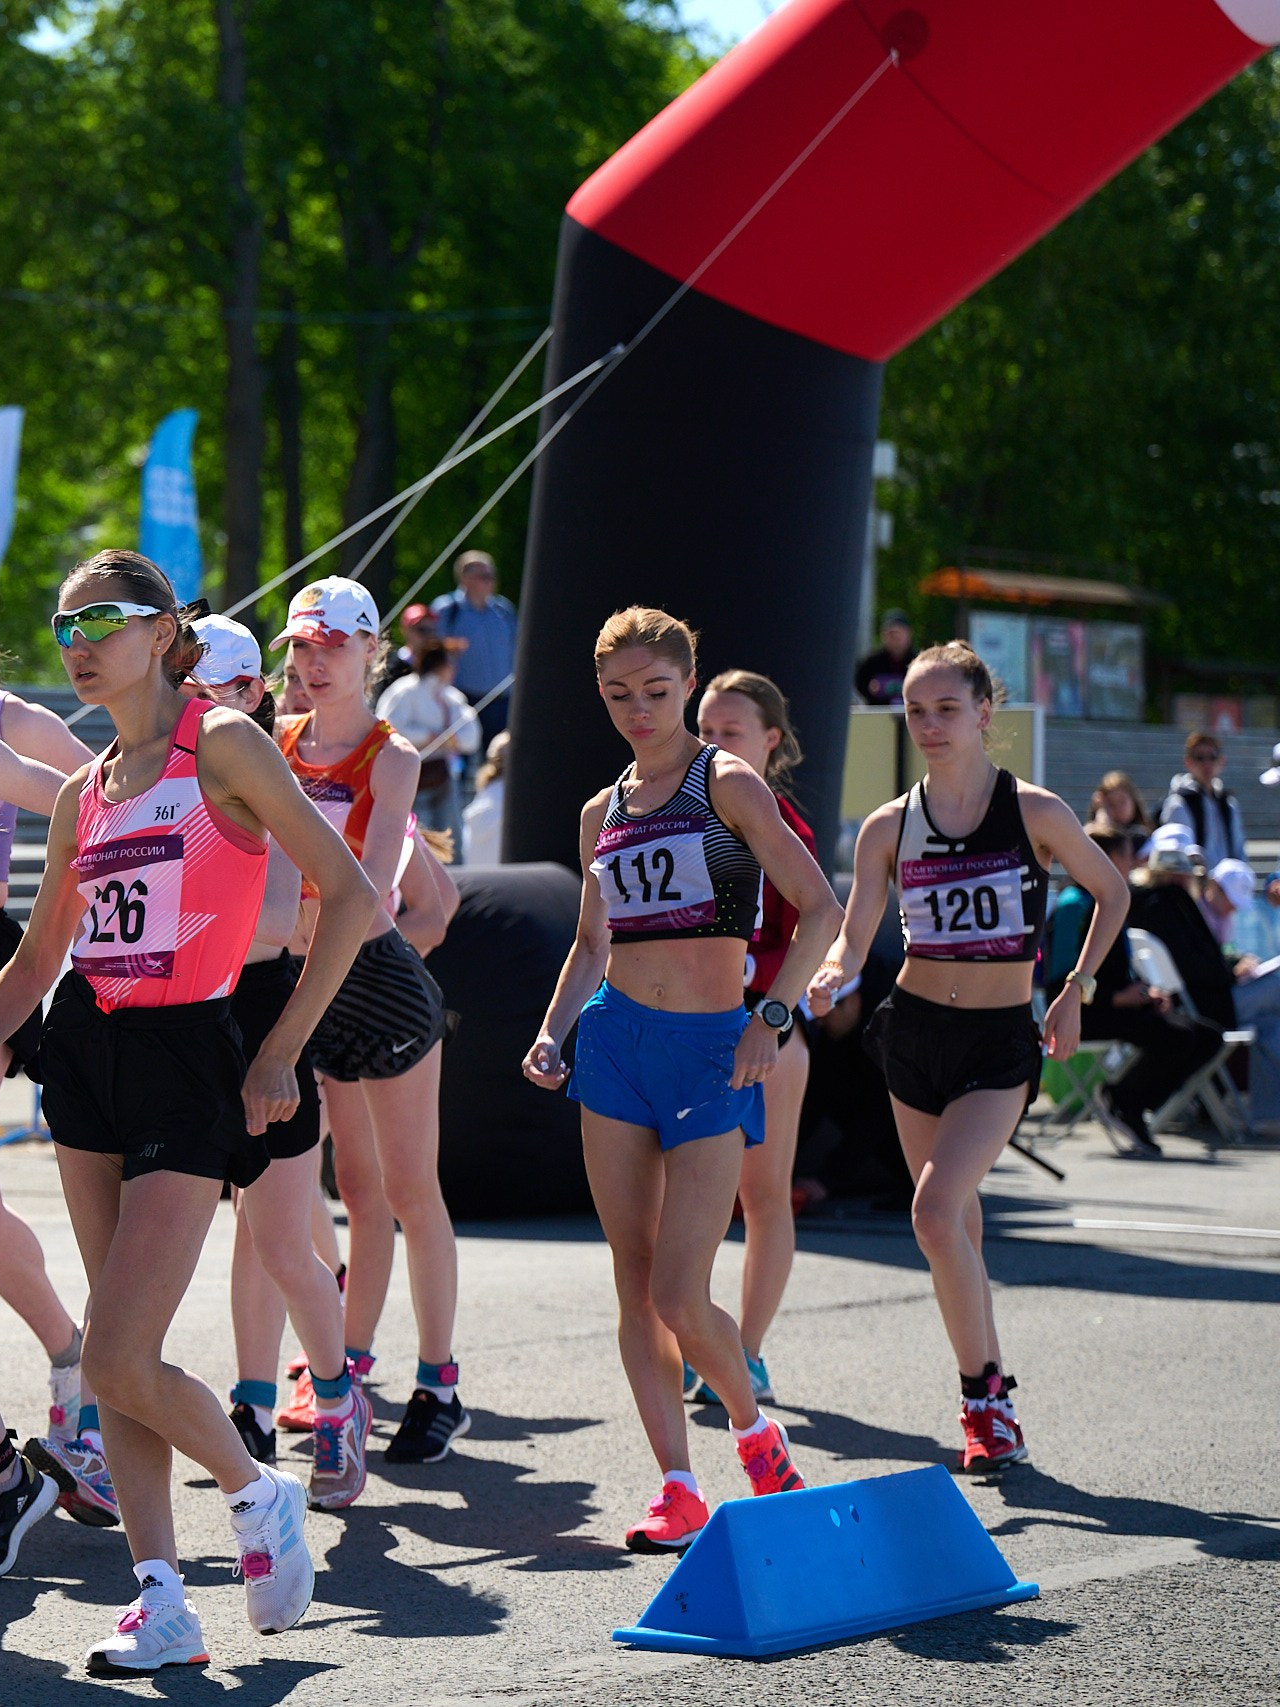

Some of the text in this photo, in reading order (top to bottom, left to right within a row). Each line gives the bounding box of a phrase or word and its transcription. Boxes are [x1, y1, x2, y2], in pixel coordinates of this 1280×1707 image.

[649, 821, 690, 832] РОССИИ
[120, 846, 165, 858] РОССИИ
[608, 848, 681, 903] 112
[924, 885, 1000, 932] 120
